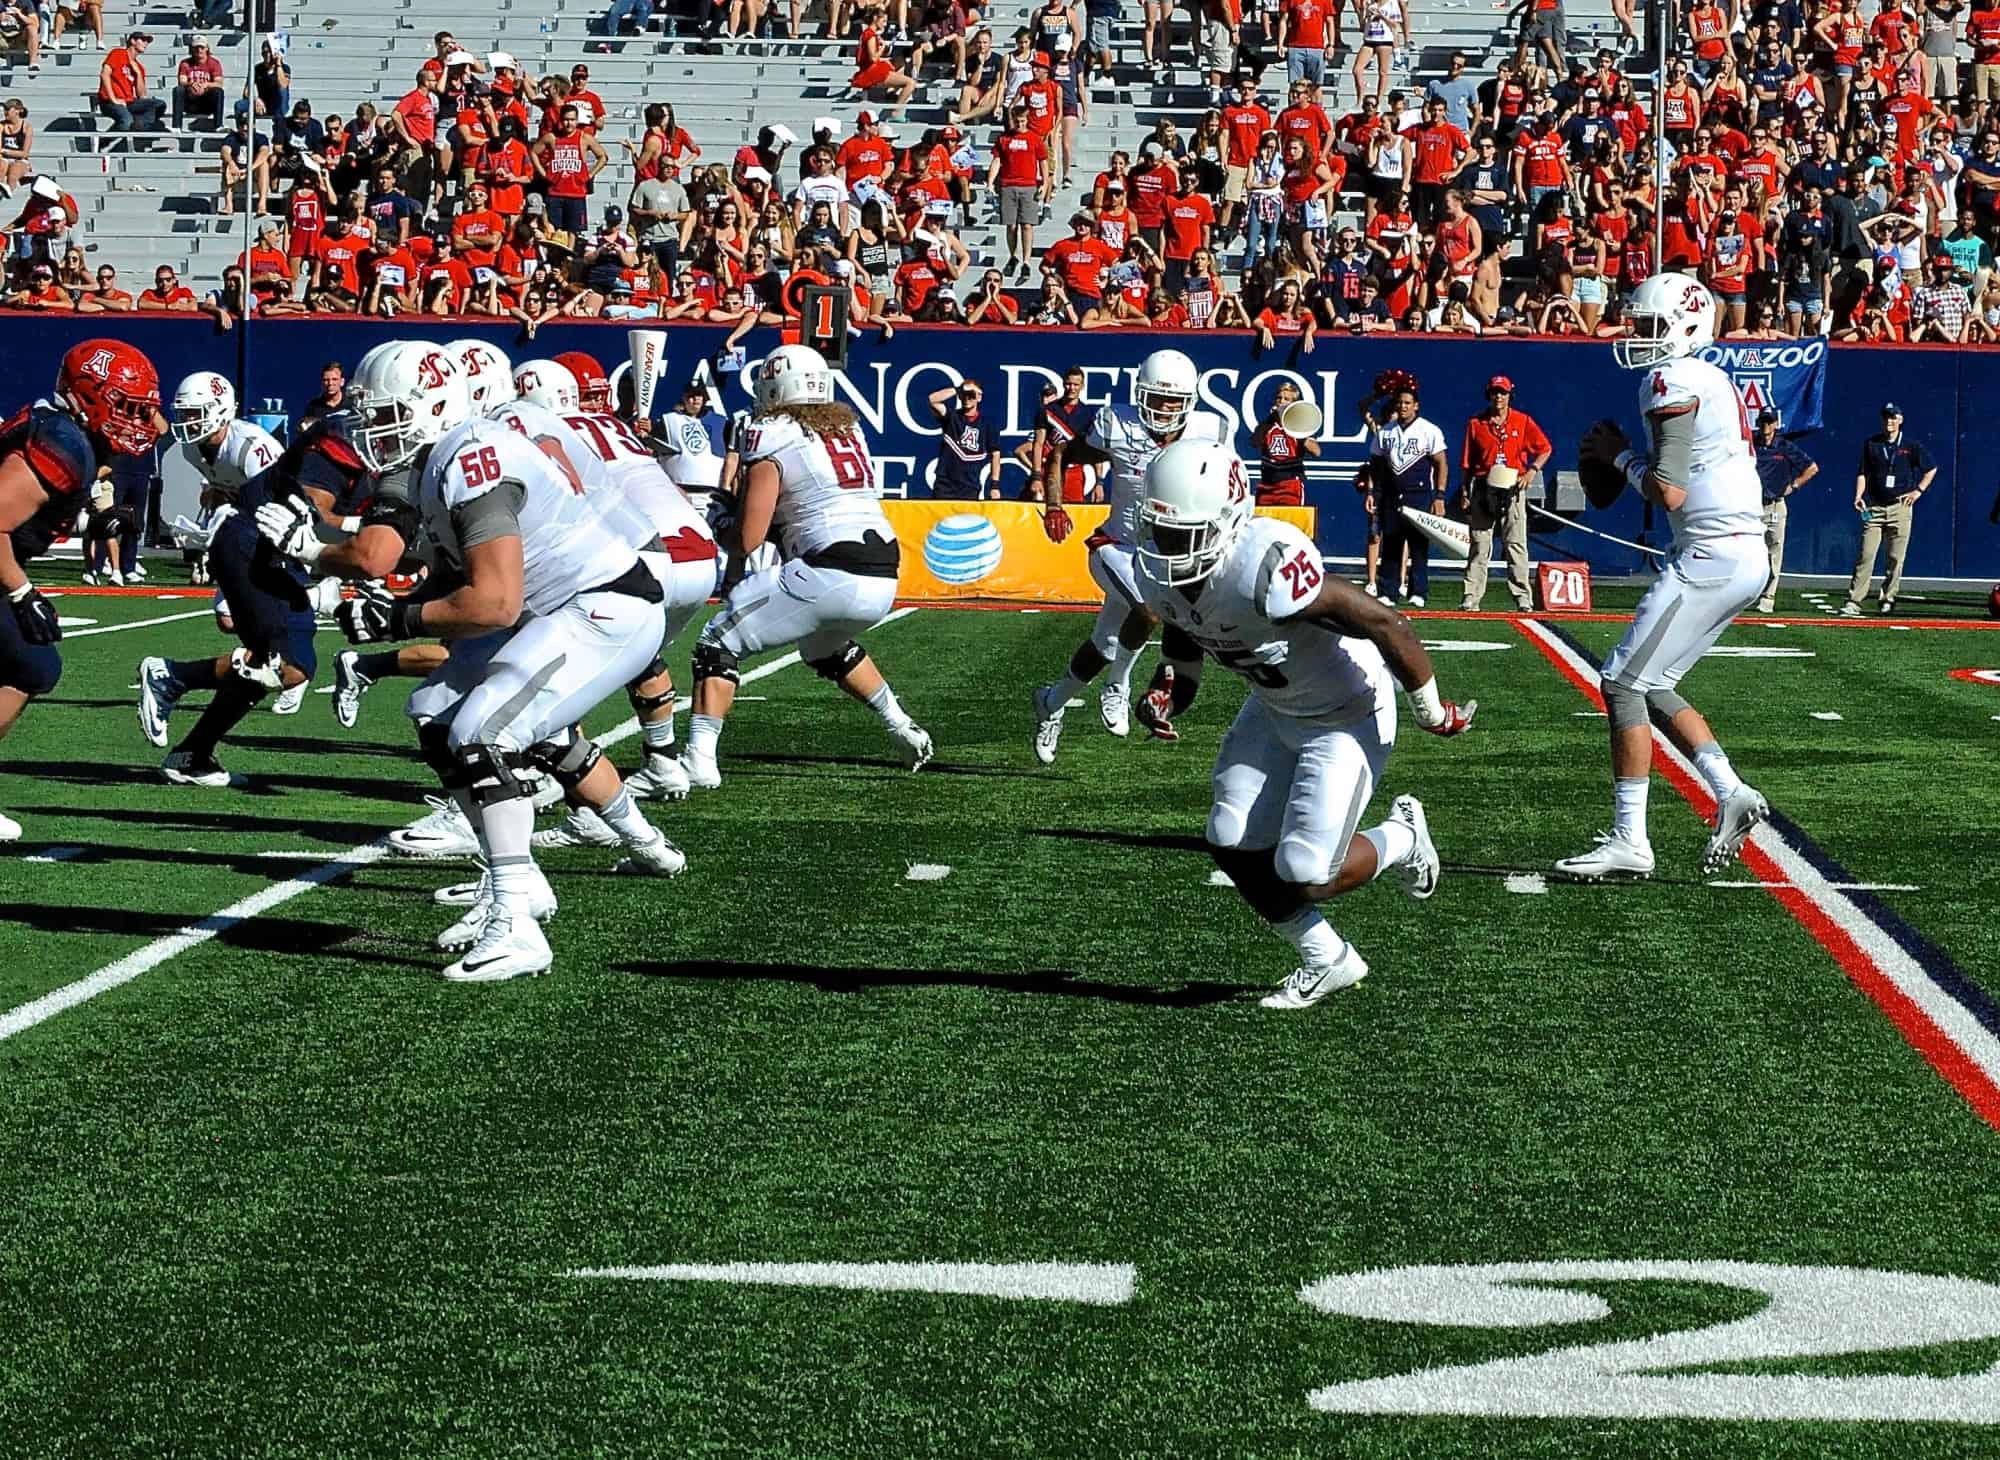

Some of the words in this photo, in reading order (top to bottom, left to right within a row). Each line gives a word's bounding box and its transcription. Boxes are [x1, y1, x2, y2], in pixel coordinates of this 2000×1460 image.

[816, 295, 834, 338] 1
[81, 349, 116, 381] A
[1700, 341, 1824, 369] ONAZOO
[1198, 368, 1369, 443] SOL
[253, 444, 274, 468] 21
[561, 415, 654, 462] 73
[819, 430, 875, 489] 61
[458, 446, 502, 489] 56
[1279, 549, 1321, 602] 25
[1547, 569, 1585, 605] 20
